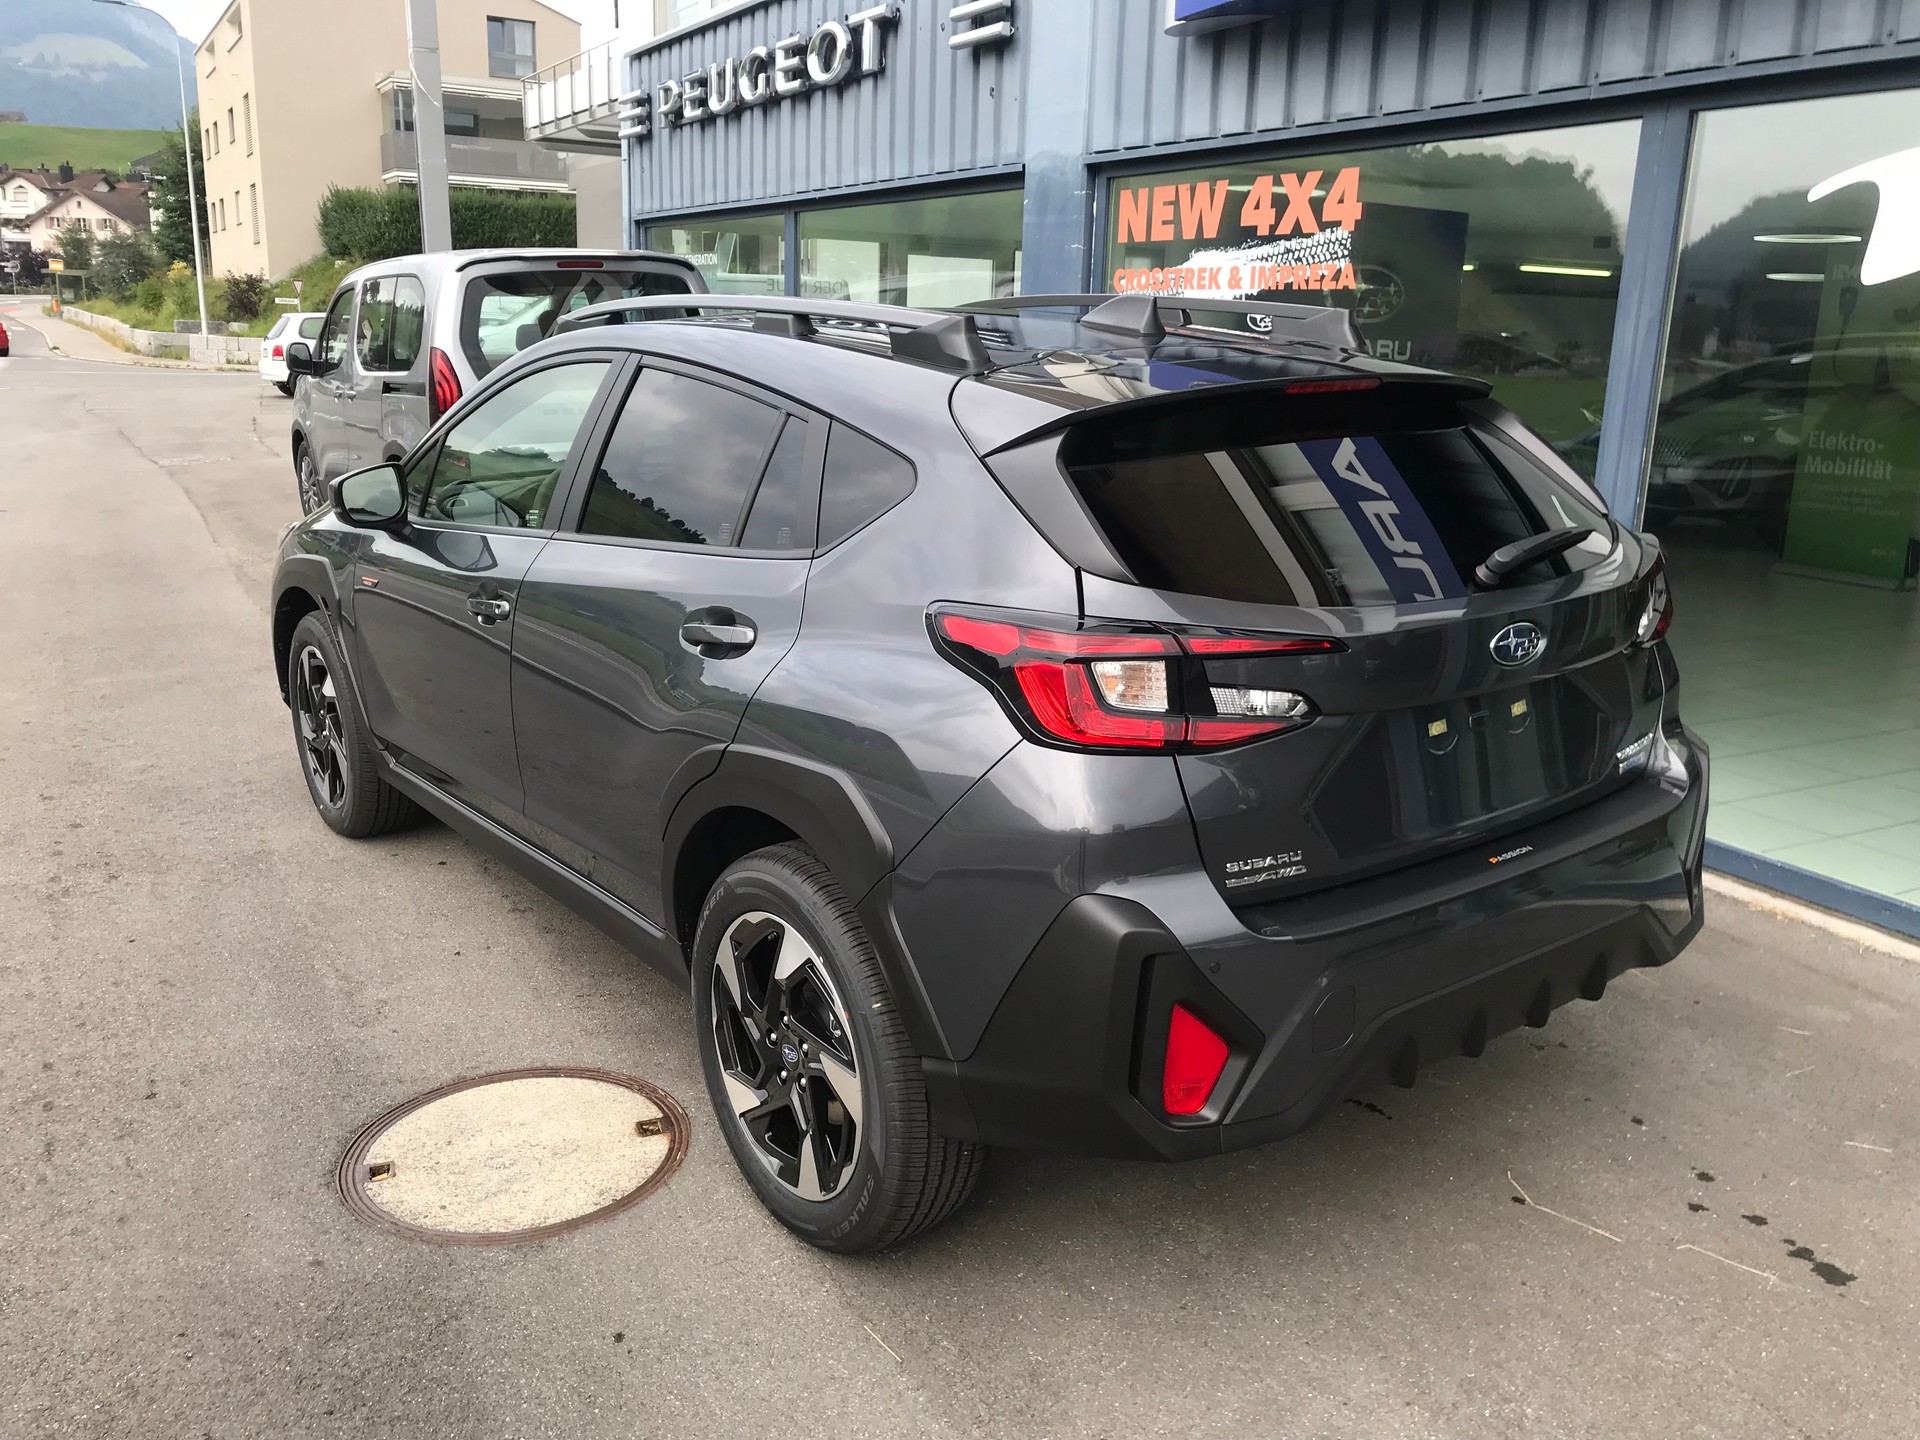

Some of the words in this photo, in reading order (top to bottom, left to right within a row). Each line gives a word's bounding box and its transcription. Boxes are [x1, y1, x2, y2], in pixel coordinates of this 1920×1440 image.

[657, 3, 899, 128] PEUGEOT
[1117, 179, 1229, 243] NEW
[1240, 167, 1363, 236] 4X4
[1113, 266, 1222, 293] CROSSTREK
[1227, 267, 1242, 290] &
[1250, 263, 1356, 290] IMPREZA
[1808, 430, 1885, 453] Elektro-
[1804, 455, 1894, 481] Mobilität
[1226, 850, 1302, 873] SUBARU
